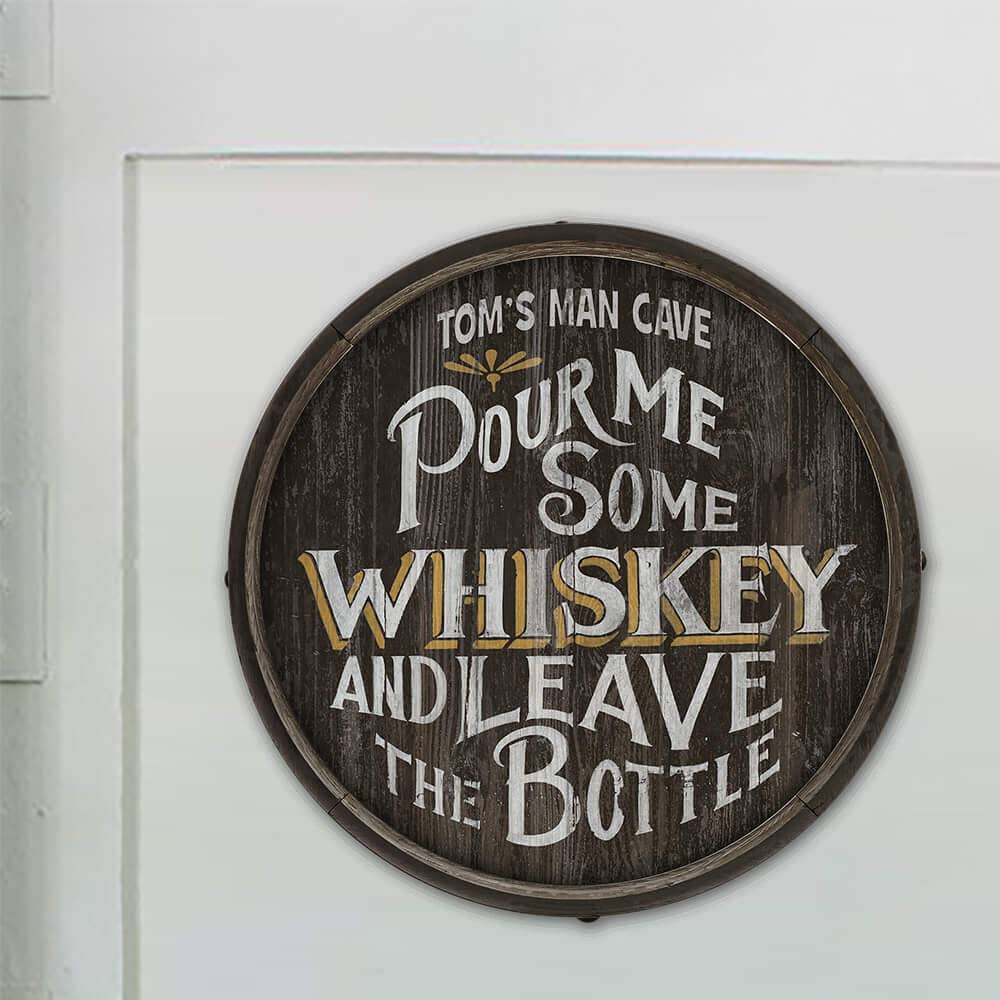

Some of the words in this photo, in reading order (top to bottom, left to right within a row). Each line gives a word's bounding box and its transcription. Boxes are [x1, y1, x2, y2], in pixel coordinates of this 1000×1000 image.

[437, 290, 535, 349] TOM'S
[548, 287, 619, 331] MAN
[632, 293, 712, 349] CAVE
[387, 358, 636, 534] POUR
[612, 347, 724, 460] ME
[538, 441, 738, 536] SOME
[298, 544, 857, 650] WHISKEY
[330, 656, 448, 725] AND
[456, 651, 783, 751] LEAVE
[375, 733, 482, 829] THE
[493, 725, 782, 848] BOTTLE
